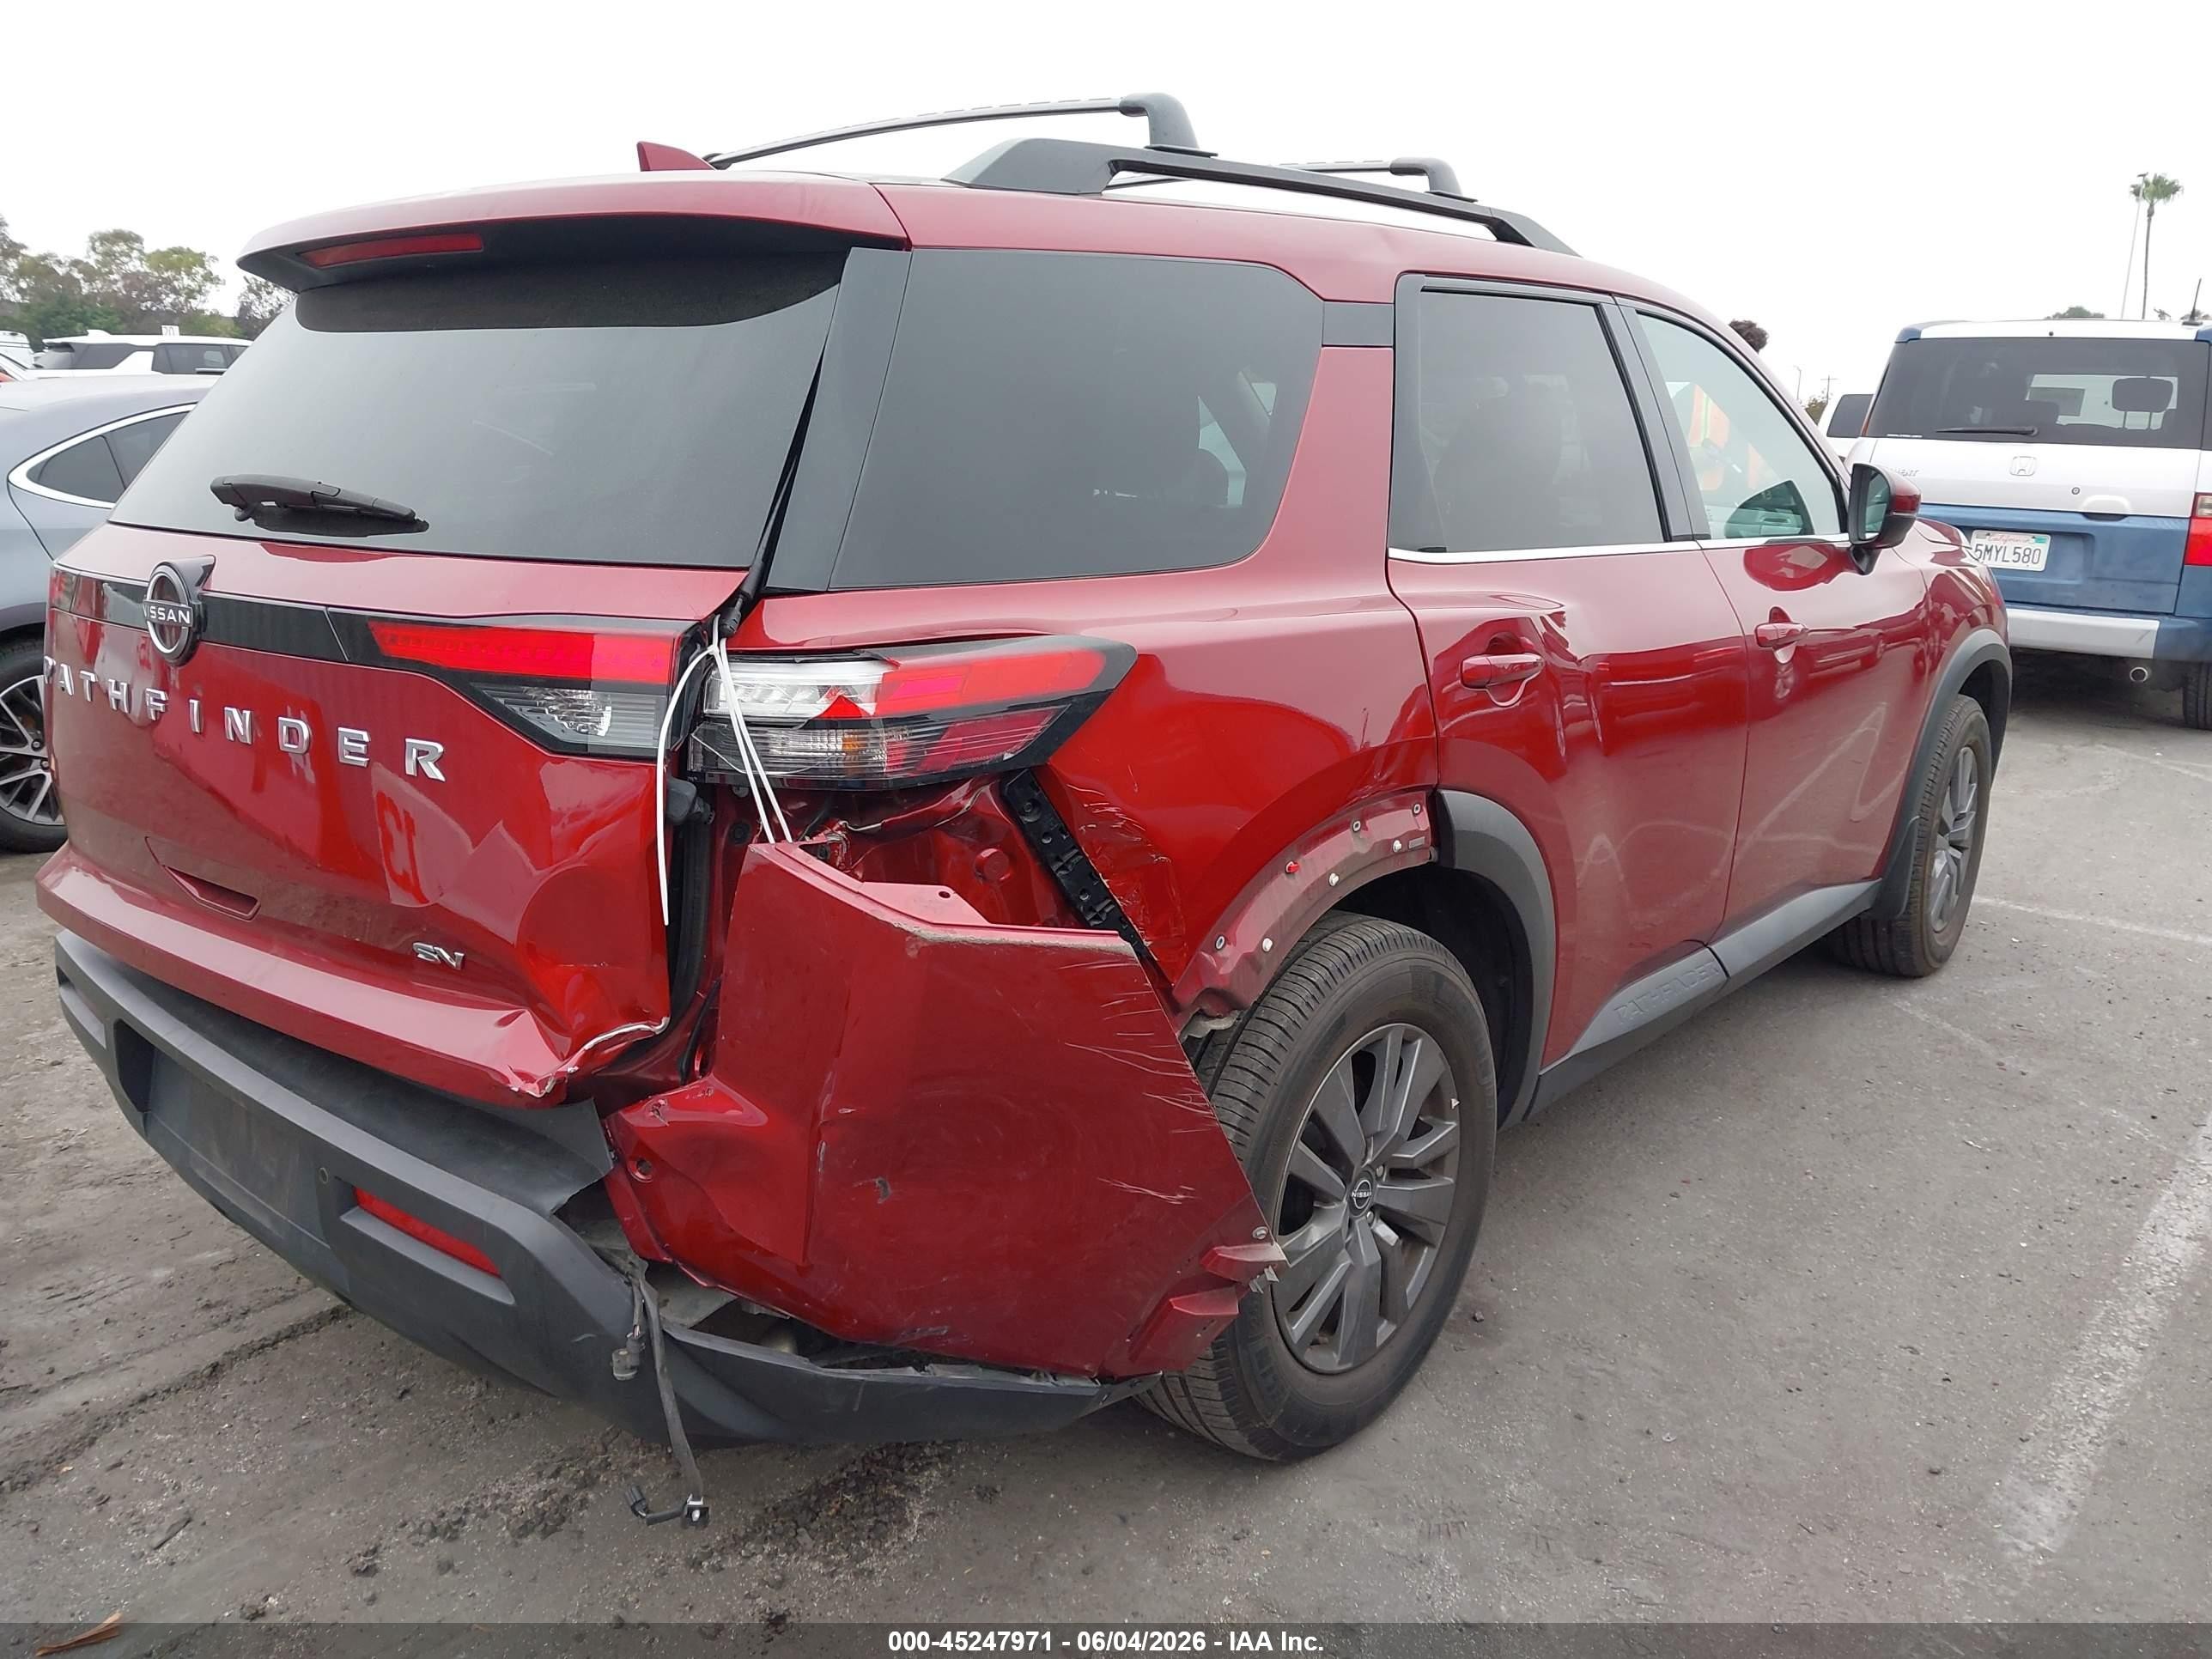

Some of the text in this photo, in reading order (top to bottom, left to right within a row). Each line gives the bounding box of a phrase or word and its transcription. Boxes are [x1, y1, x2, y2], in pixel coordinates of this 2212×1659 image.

[1975, 543, 2042, 565] 5MYL580
[143, 602, 191, 625] NISSAN
[44, 655, 446, 782] PATHFINDER
[1614, 961, 1719, 1025] PATHFINDER
